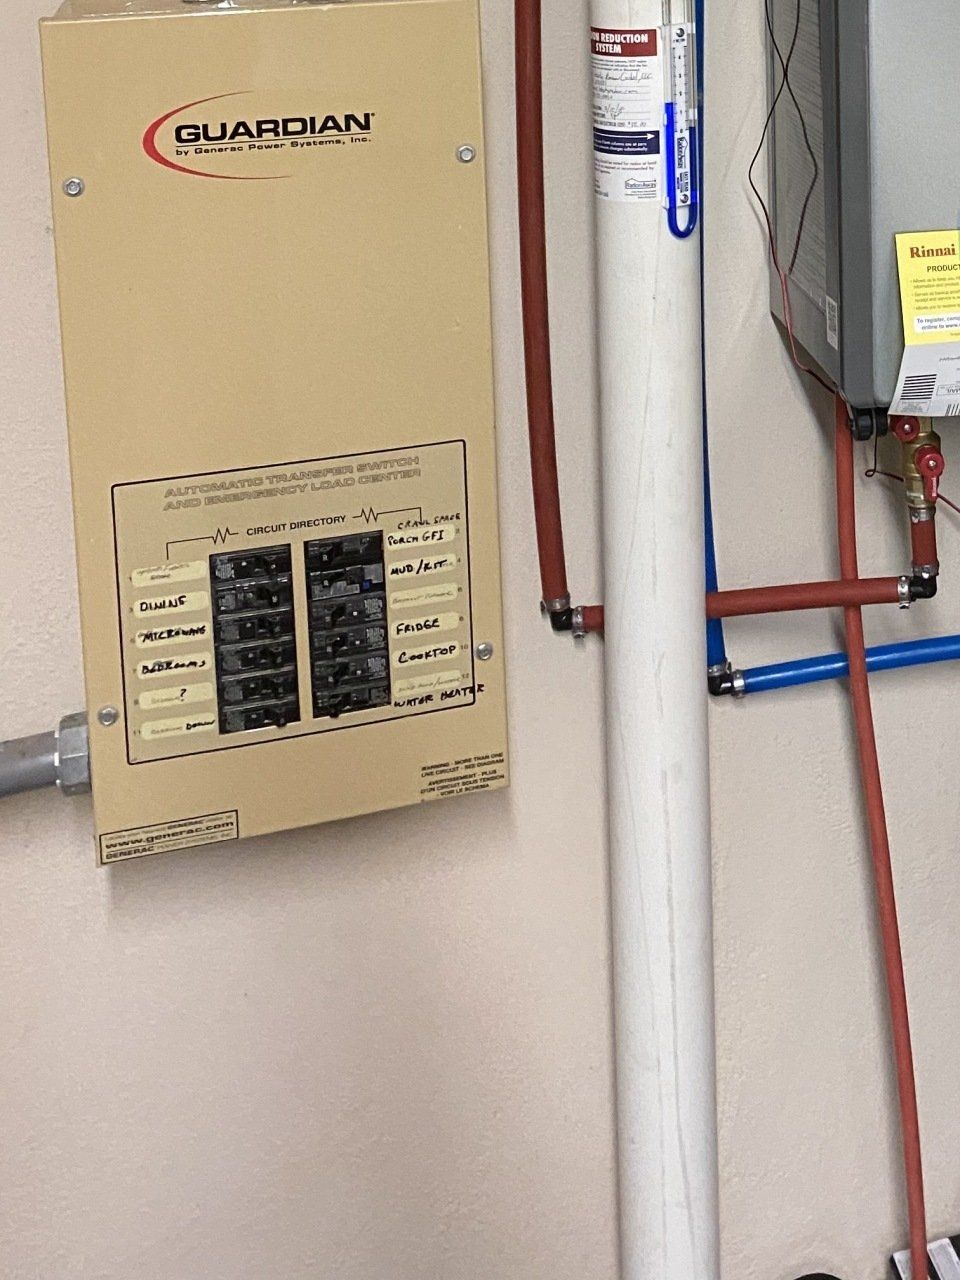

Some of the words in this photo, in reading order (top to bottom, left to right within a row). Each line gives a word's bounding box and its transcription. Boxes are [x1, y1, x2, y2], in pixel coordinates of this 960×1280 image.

[601, 33, 649, 43] REDUCTION
[595, 42, 622, 54] SYSTEM
[174, 112, 372, 144] GUARDIAN
[175, 148, 189, 156] by
[194, 145, 243, 154] Generac
[248, 142, 286, 151] Power
[290, 138, 346, 148] Systems,
[909, 243, 956, 259] Rinnai
[163, 476, 264, 498] AUTOMATIC
[265, 464, 354, 484] TRANSFER
[356, 456, 420, 472] SWITCH
[162, 497, 202, 512] AND
[204, 483, 308, 506] EMERGENCY
[310, 476, 355, 491] LOAD
[357, 468, 421, 485] CENTER
[246, 523, 287, 536] CIRCUIT
[289, 515, 346, 530] DIRECTORY
[387, 535, 419, 547] PORCH
[422, 529, 445, 542] GFI
[396, 618, 440, 636] FRIDGE
[398, 645, 456, 663] COOKTOP
[394, 694, 434, 707] WATER
[440, 684, 485, 701] HEATER
[435, 767, 459, 775] CIRCUIT
[476, 758, 505, 767] DIAGRAM
[437, 783, 460, 791] CIRCUIT
[479, 774, 504, 783] TENSION
[105, 821, 234, 849] www.generac.com
[106, 845, 155, 860] GENERAC
